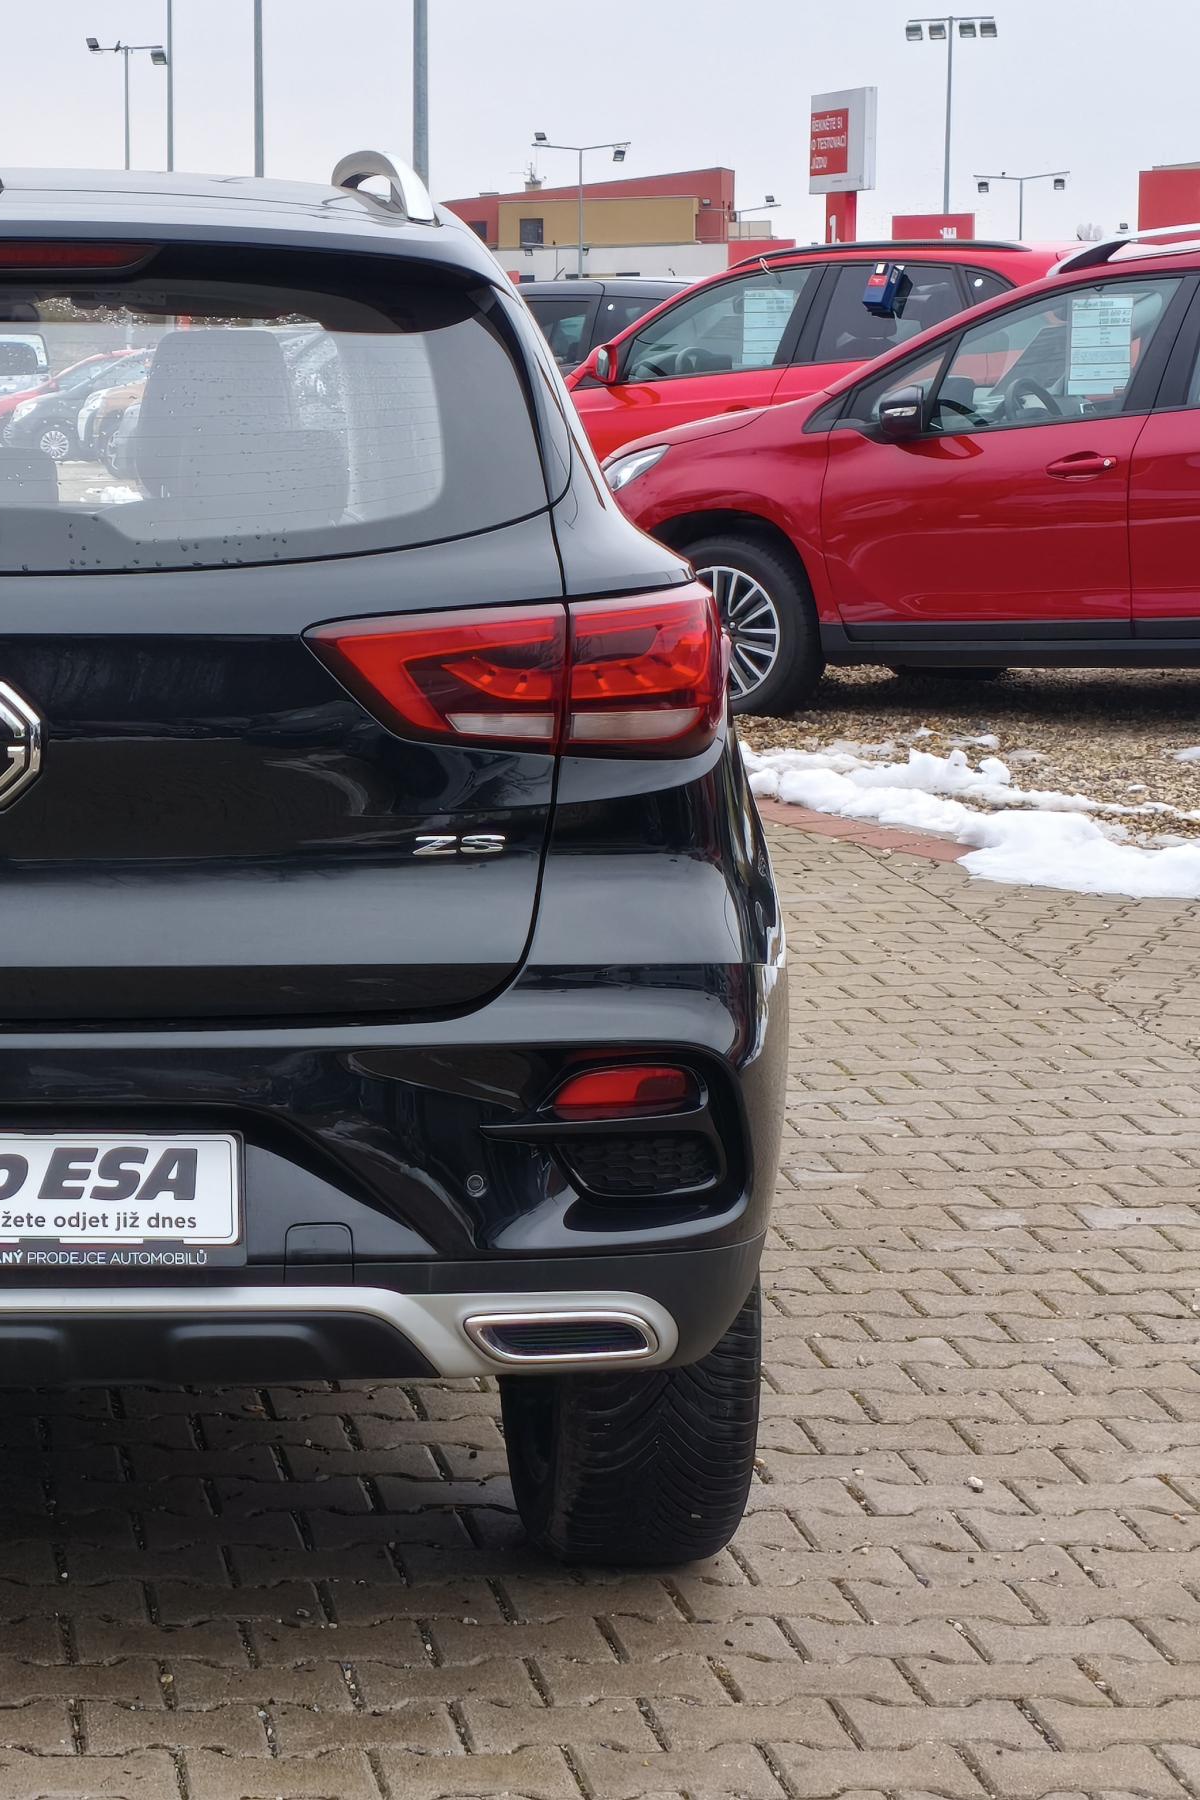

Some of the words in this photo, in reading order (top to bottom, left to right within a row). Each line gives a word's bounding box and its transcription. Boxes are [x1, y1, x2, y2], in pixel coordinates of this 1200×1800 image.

[412, 835, 505, 855] ZS
[37, 1146, 198, 1201] ESA
[53, 1212, 109, 1231] odjet
[115, 1211, 140, 1231] již
[147, 1212, 197, 1229] dnes
[27, 1251, 107, 1265] PRODEJCE
[110, 1248, 208, 1265] AUTOMOBILŮ
